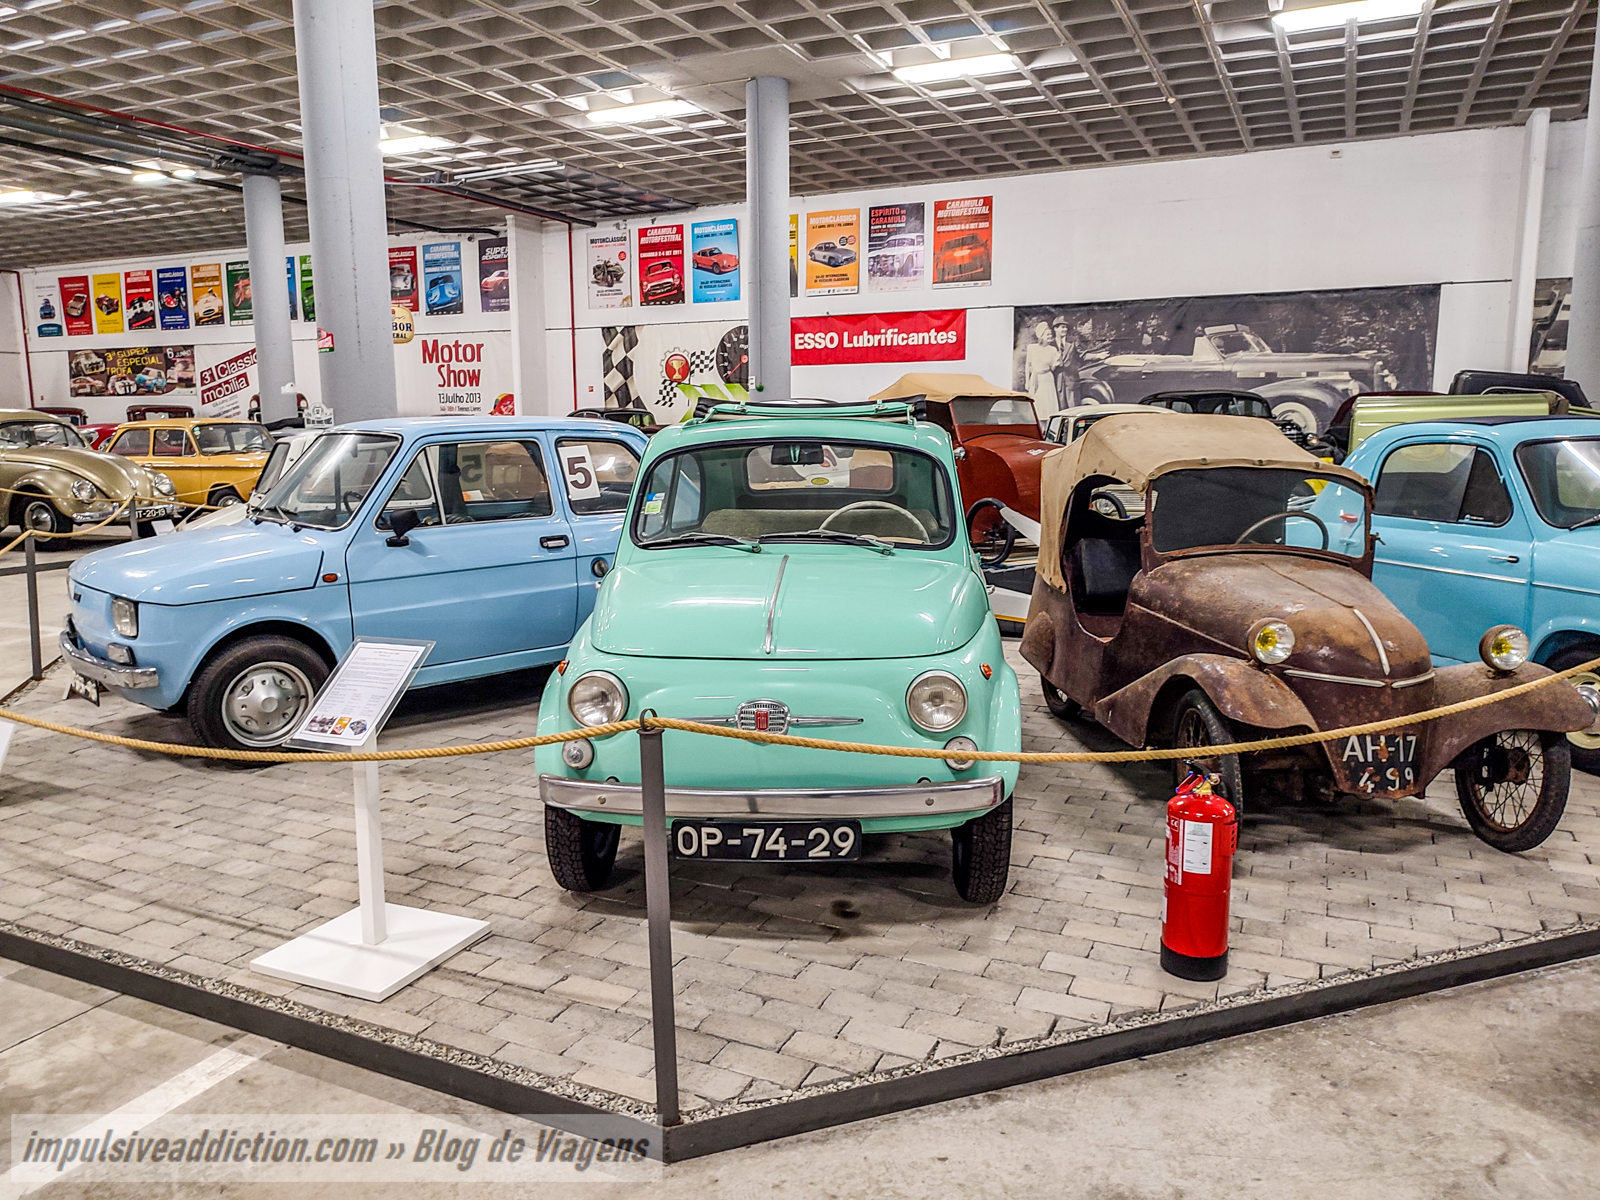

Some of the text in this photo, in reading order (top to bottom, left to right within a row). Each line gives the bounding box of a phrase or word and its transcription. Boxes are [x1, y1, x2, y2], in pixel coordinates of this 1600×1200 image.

[946, 198, 984, 209] CARAMULO
[871, 207, 900, 217] ESPÍRITO
[937, 206, 990, 218] MOTORFESTIVAL
[810, 214, 856, 224] MOTORCLÁSSICO
[871, 215, 906, 225] CARAMULO
[647, 227, 677, 236] CARAMULO
[590, 236, 627, 245] MOTORCLÁSSICO
[640, 234, 682, 244] MOTORFESTIVAL
[794, 329, 957, 350] ESSO Lubrificantes
[117, 347, 149, 358] SUPER
[166, 347, 174, 359] 6
[421, 339, 484, 364] Motor
[117, 356, 163, 367] ESPECIAL
[106, 367, 133, 376] TROFA
[437, 364, 481, 387] Show
[204, 377, 247, 403] mobilia
[445, 393, 464, 403] Julho
[465, 392, 481, 403] 2013
[567, 456, 592, 489] 5
[1342, 735, 1417, 762] AH-17
[677, 826, 856, 858] OP-74-29
